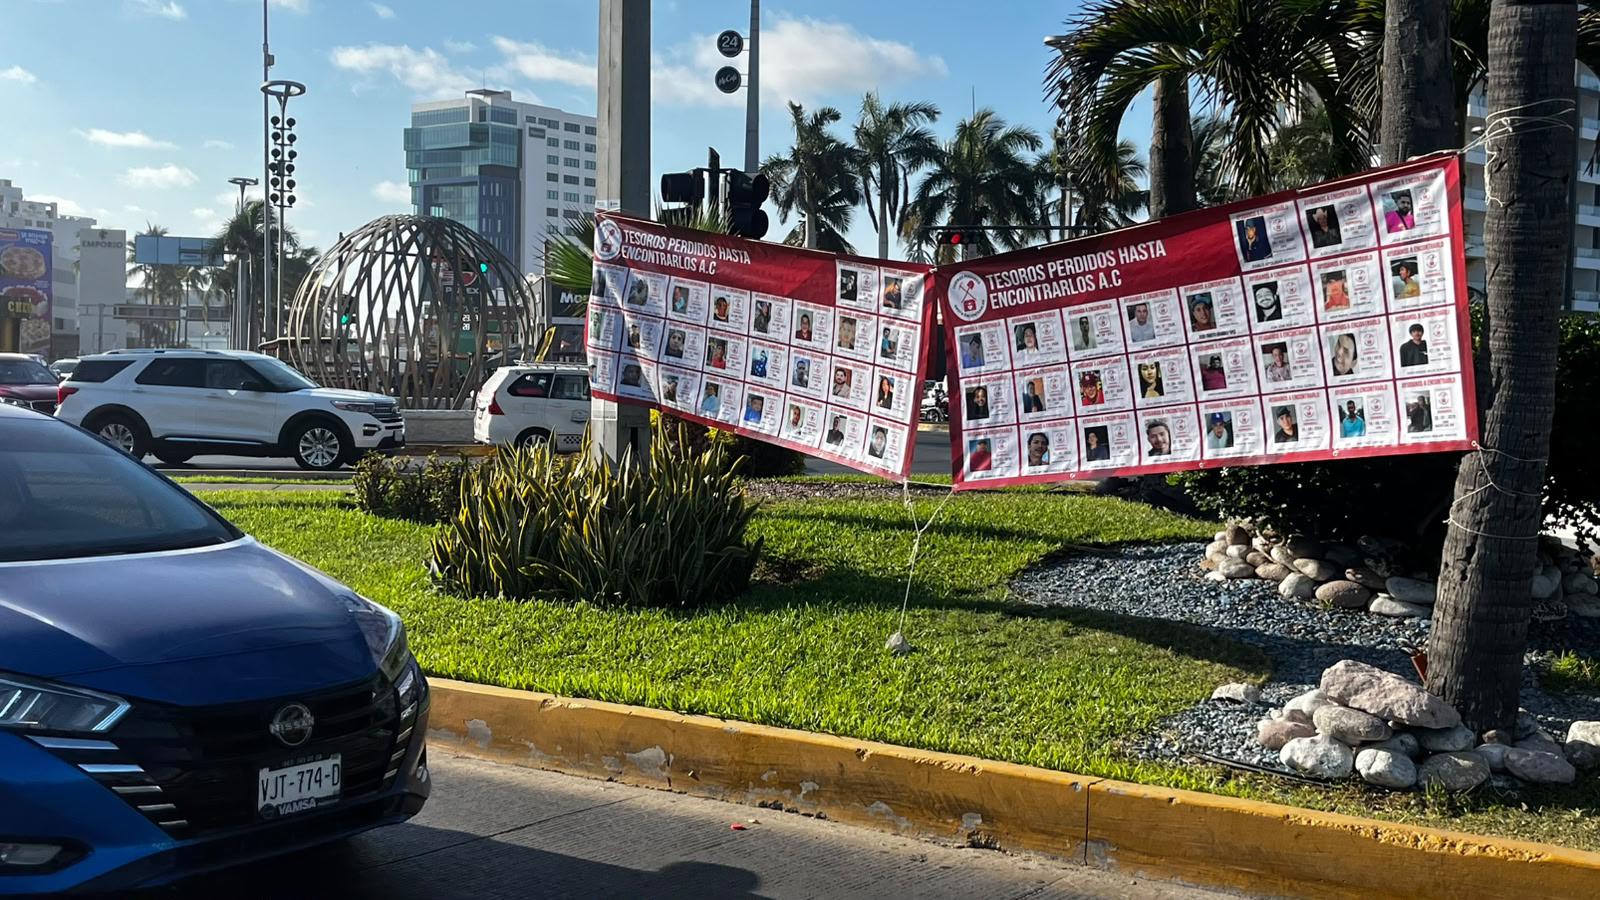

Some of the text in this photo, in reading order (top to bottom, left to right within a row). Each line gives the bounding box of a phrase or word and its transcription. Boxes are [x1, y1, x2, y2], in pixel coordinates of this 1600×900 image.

[722, 35, 738, 48] 24
[621, 245, 716, 276] ENCONTRARLOS A.C
[622, 229, 751, 265] TESOROS PERDIDOS HASTA
[986, 264, 1046, 291] TESOROS
[1047, 250, 1117, 278] PERDIDOS
[1118, 239, 1167, 265] HASTA
[989, 277, 1096, 310] ENCONTRARLOS
[1099, 269, 1122, 289] A.C
[269, 716, 315, 734] NISSAN
[261, 763, 340, 802] VJT-774-D
